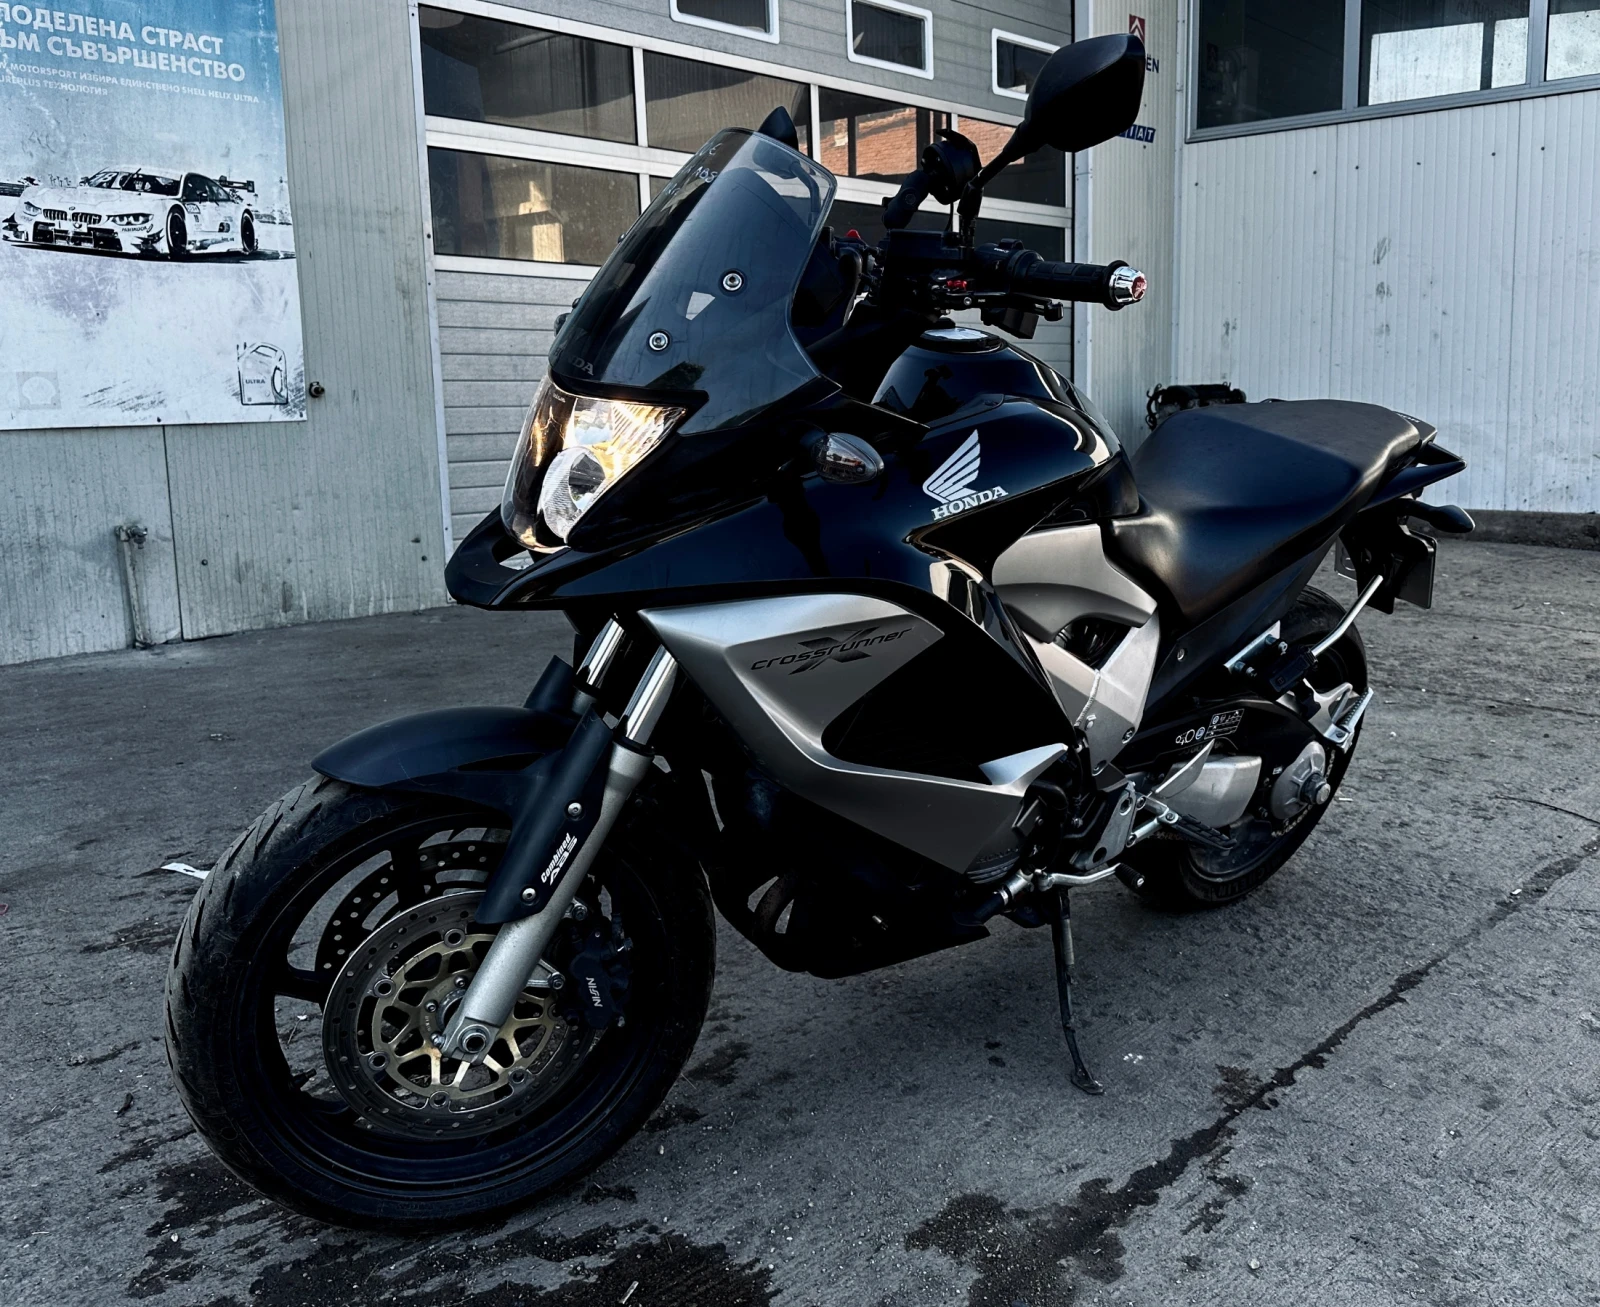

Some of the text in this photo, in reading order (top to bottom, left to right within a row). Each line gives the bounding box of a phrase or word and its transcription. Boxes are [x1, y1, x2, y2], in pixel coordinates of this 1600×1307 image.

[46, 36, 246, 82] СЪВЪРШЕНСТВО
[141, 25, 224, 55] СТРАСТ
[10, 63, 77, 79] MOTORSPORT
[79, 72, 118, 85] ИЗБИРА
[120, 77, 180, 94] ЕДИНСТВЕНО
[181, 86, 206, 97] SHELL
[208, 89, 231, 100] HELIX
[233, 93, 259, 104] ULTRA
[43, 80, 108, 96] ТЕХНОЛОГИЯ
[930, 485, 1009, 521] HONDA
[750, 626, 915, 671] crossrunner
[541, 832, 571, 884] Combined
[549, 835, 578, 887] ABS
